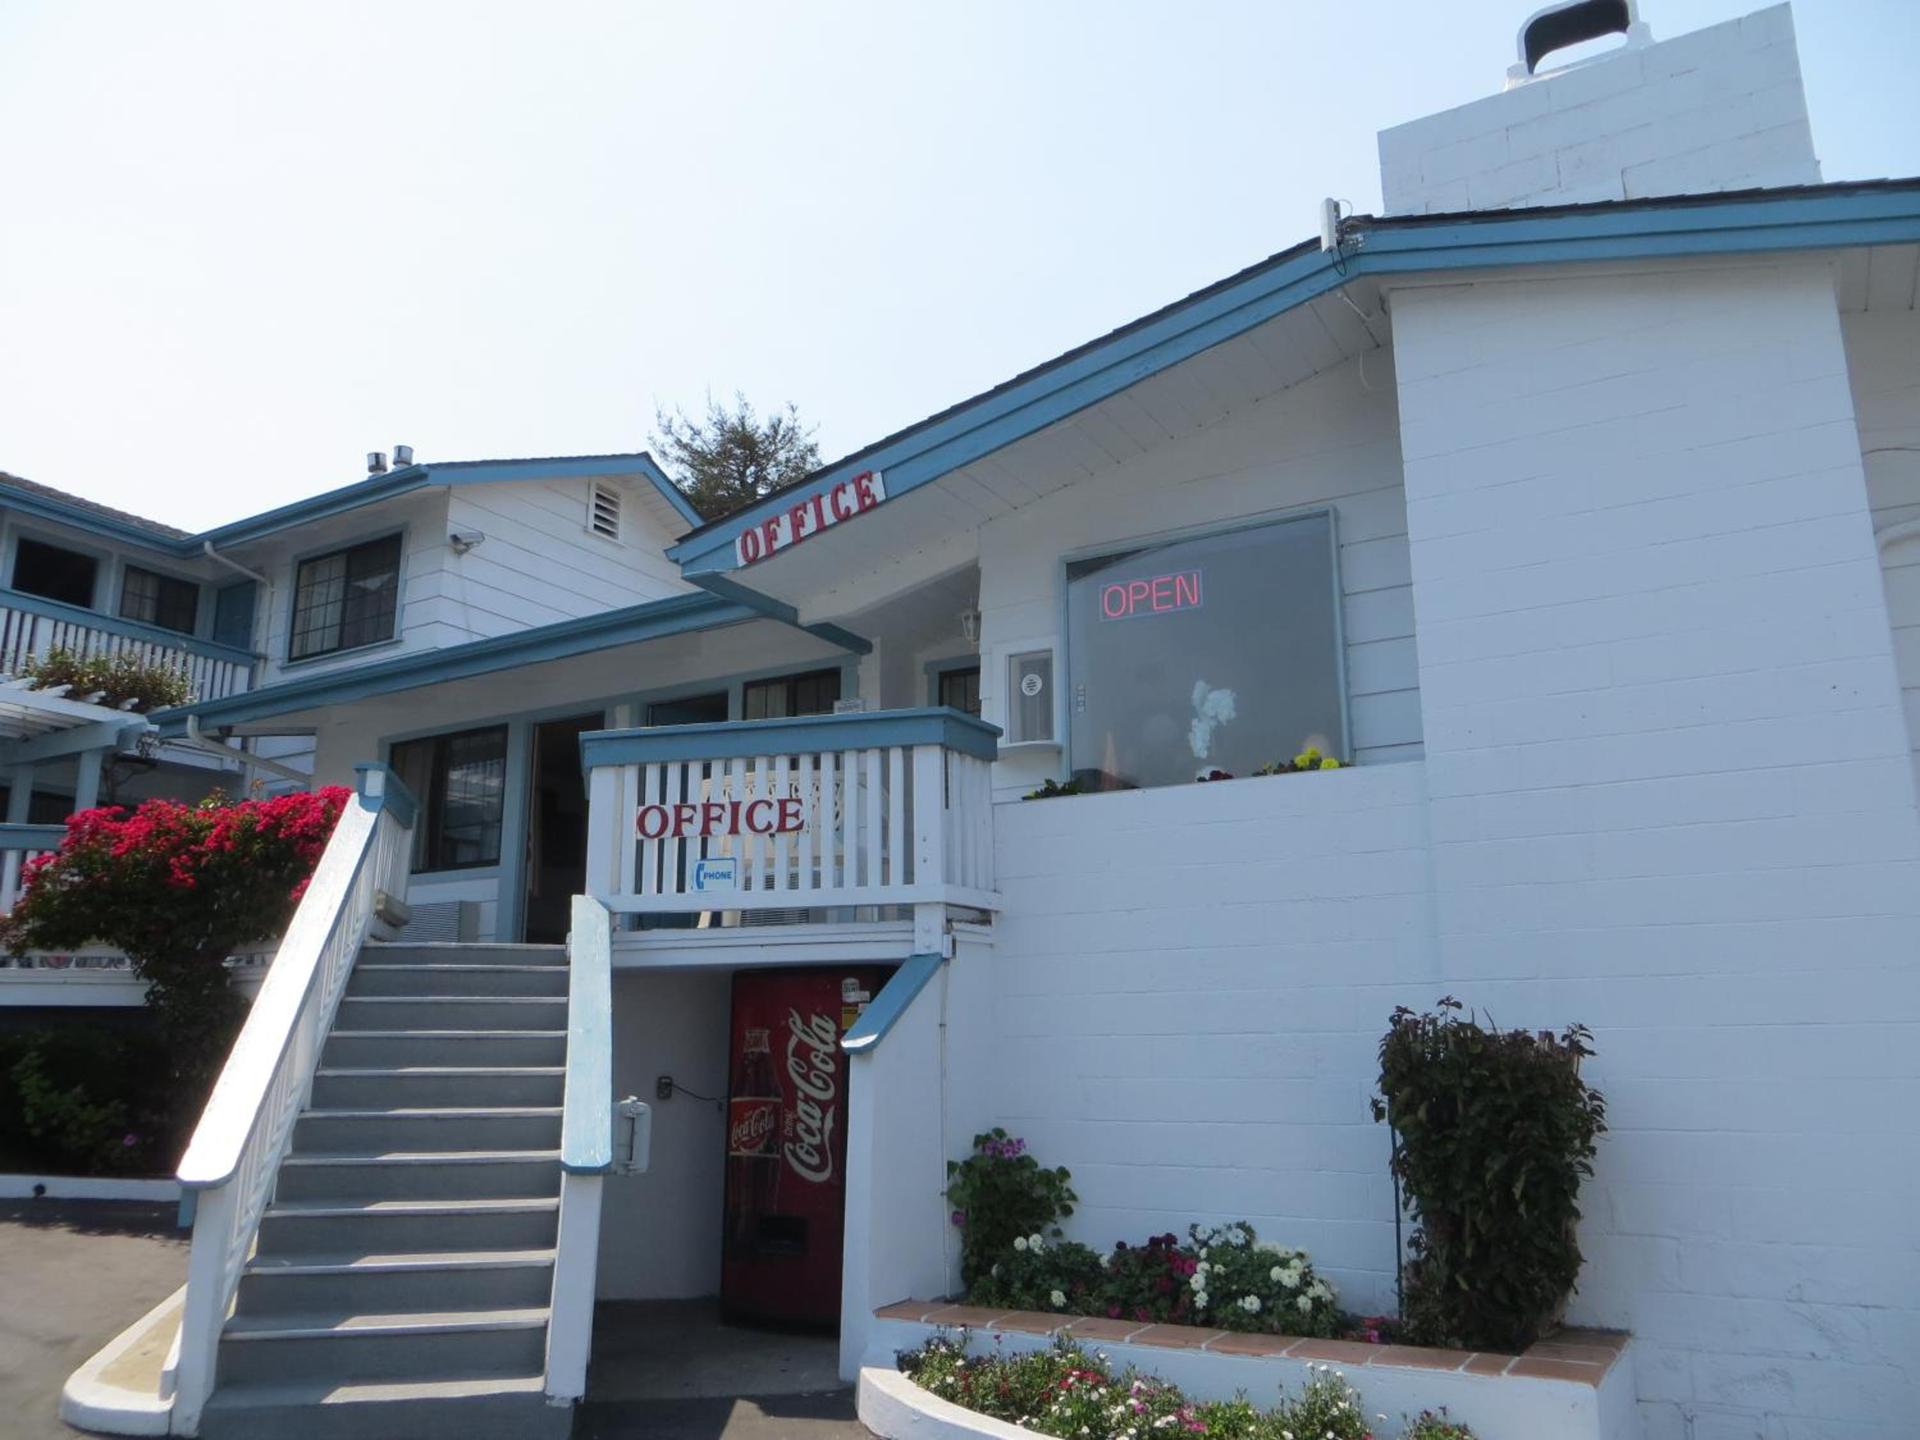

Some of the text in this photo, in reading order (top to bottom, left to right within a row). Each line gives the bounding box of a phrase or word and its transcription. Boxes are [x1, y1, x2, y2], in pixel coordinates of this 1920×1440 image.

[741, 470, 877, 564] OFFICE
[1104, 573, 1198, 617] OPEN
[637, 798, 805, 839] OFFICE
[703, 871, 732, 880] PHONE
[784, 1007, 837, 1183] Coca-Cola
